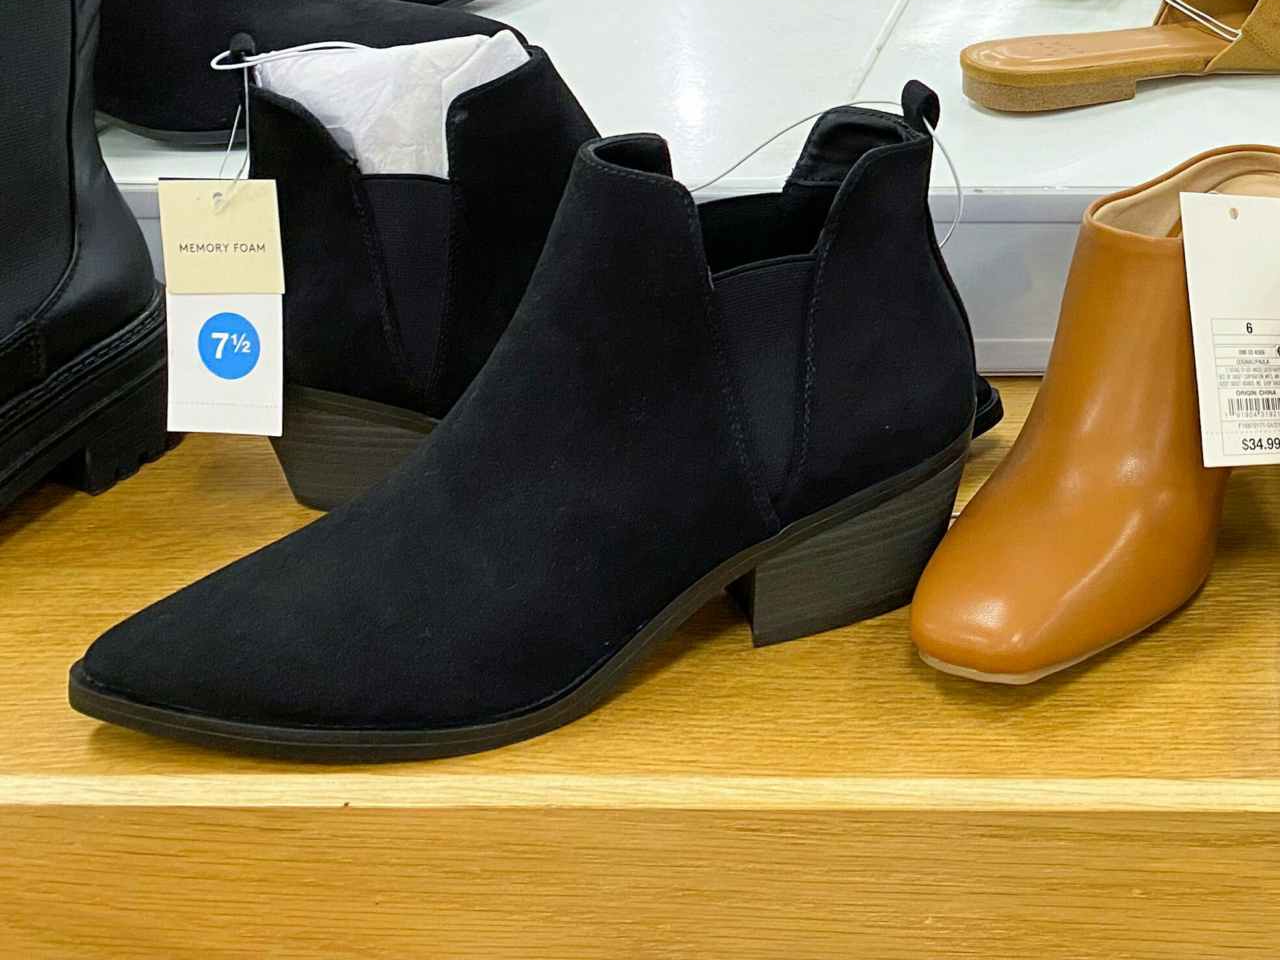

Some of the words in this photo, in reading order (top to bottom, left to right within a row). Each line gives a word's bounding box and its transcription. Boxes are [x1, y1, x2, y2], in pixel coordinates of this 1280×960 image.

[179, 243, 229, 253] MEMORY
[233, 243, 266, 253] FOAM
[1246, 322, 1253, 334] 6
[1241, 437, 1280, 451] $34.99
